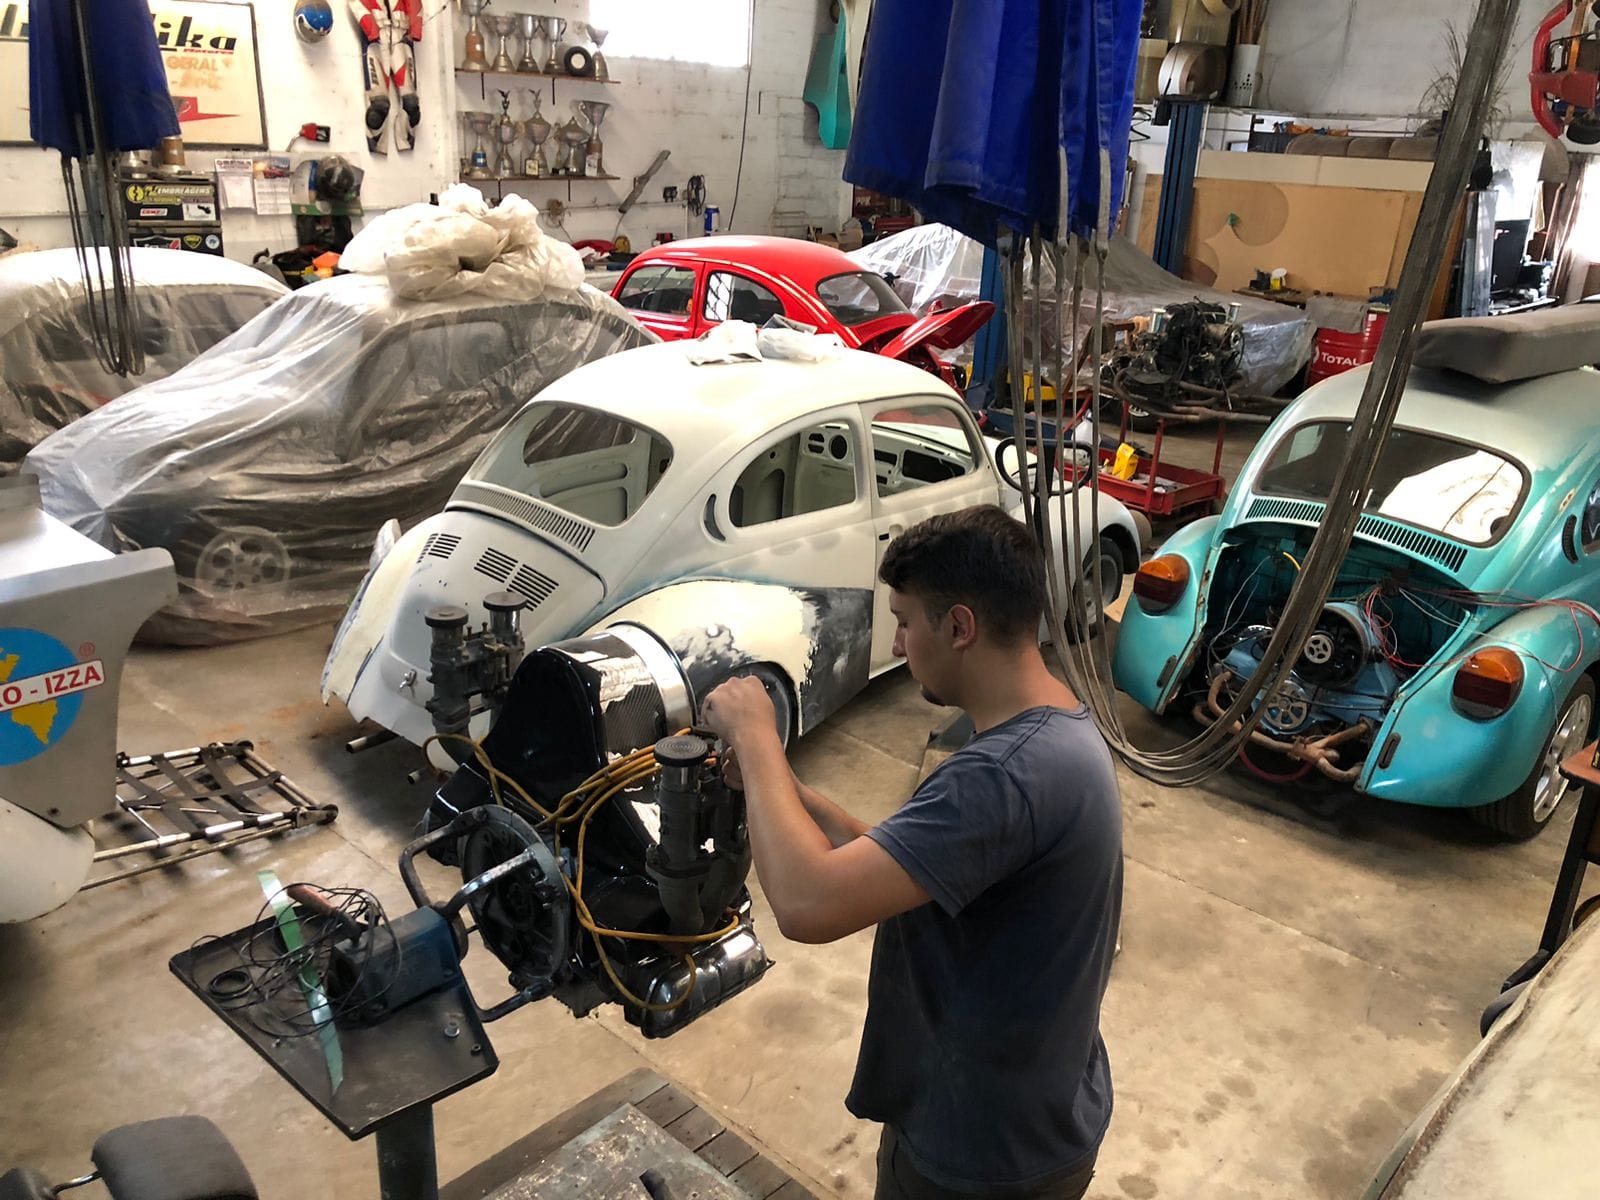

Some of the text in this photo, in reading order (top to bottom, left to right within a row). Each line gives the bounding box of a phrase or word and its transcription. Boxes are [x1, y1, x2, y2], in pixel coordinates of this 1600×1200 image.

[151, 13, 237, 51] ika
[1321, 351, 1360, 366] TOTAL
[45, 665, 102, 695] IZZA
